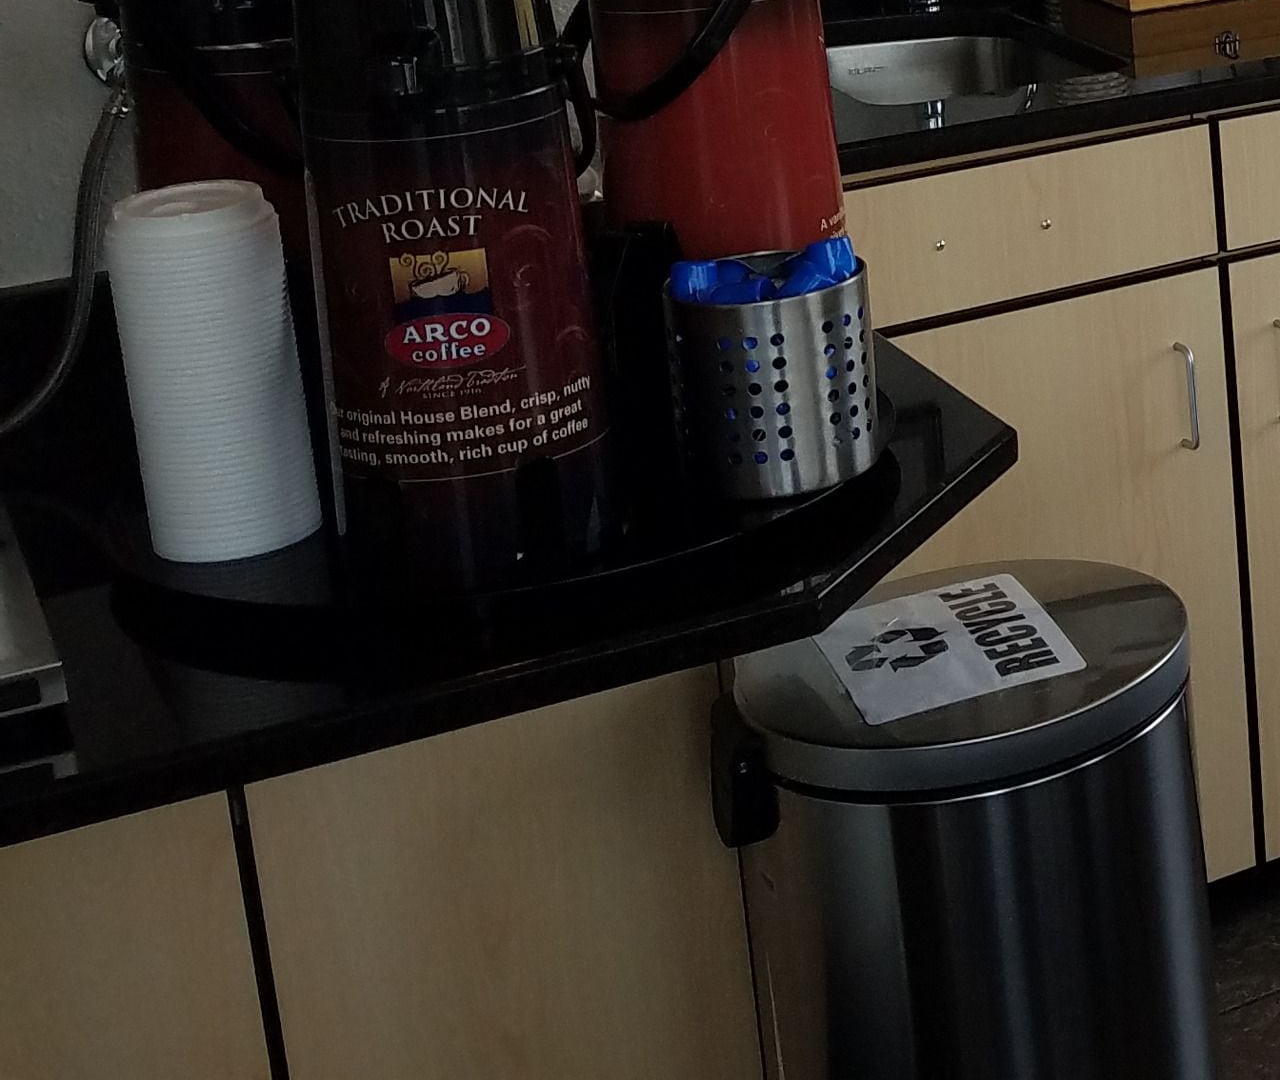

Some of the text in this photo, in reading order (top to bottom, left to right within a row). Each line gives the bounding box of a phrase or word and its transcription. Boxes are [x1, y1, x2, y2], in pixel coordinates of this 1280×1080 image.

[332, 185, 530, 229] TRADITIONAL
[380, 214, 484, 244] ROAST
[401, 317, 492, 345] ARCO
[410, 339, 487, 365] coffee
[346, 408, 396, 427] original
[400, 410, 455, 426] House
[459, 396, 516, 422] Blend,
[520, 389, 562, 410] crisp,
[563, 374, 592, 398] nutty
[422, 390, 456, 400] SINCE
[338, 417, 589, 467] tasting, smooth, rich cup of coffee
[339, 399, 583, 447] and refreshing makes for a great
[938, 582, 1062, 678] RECYCLE
